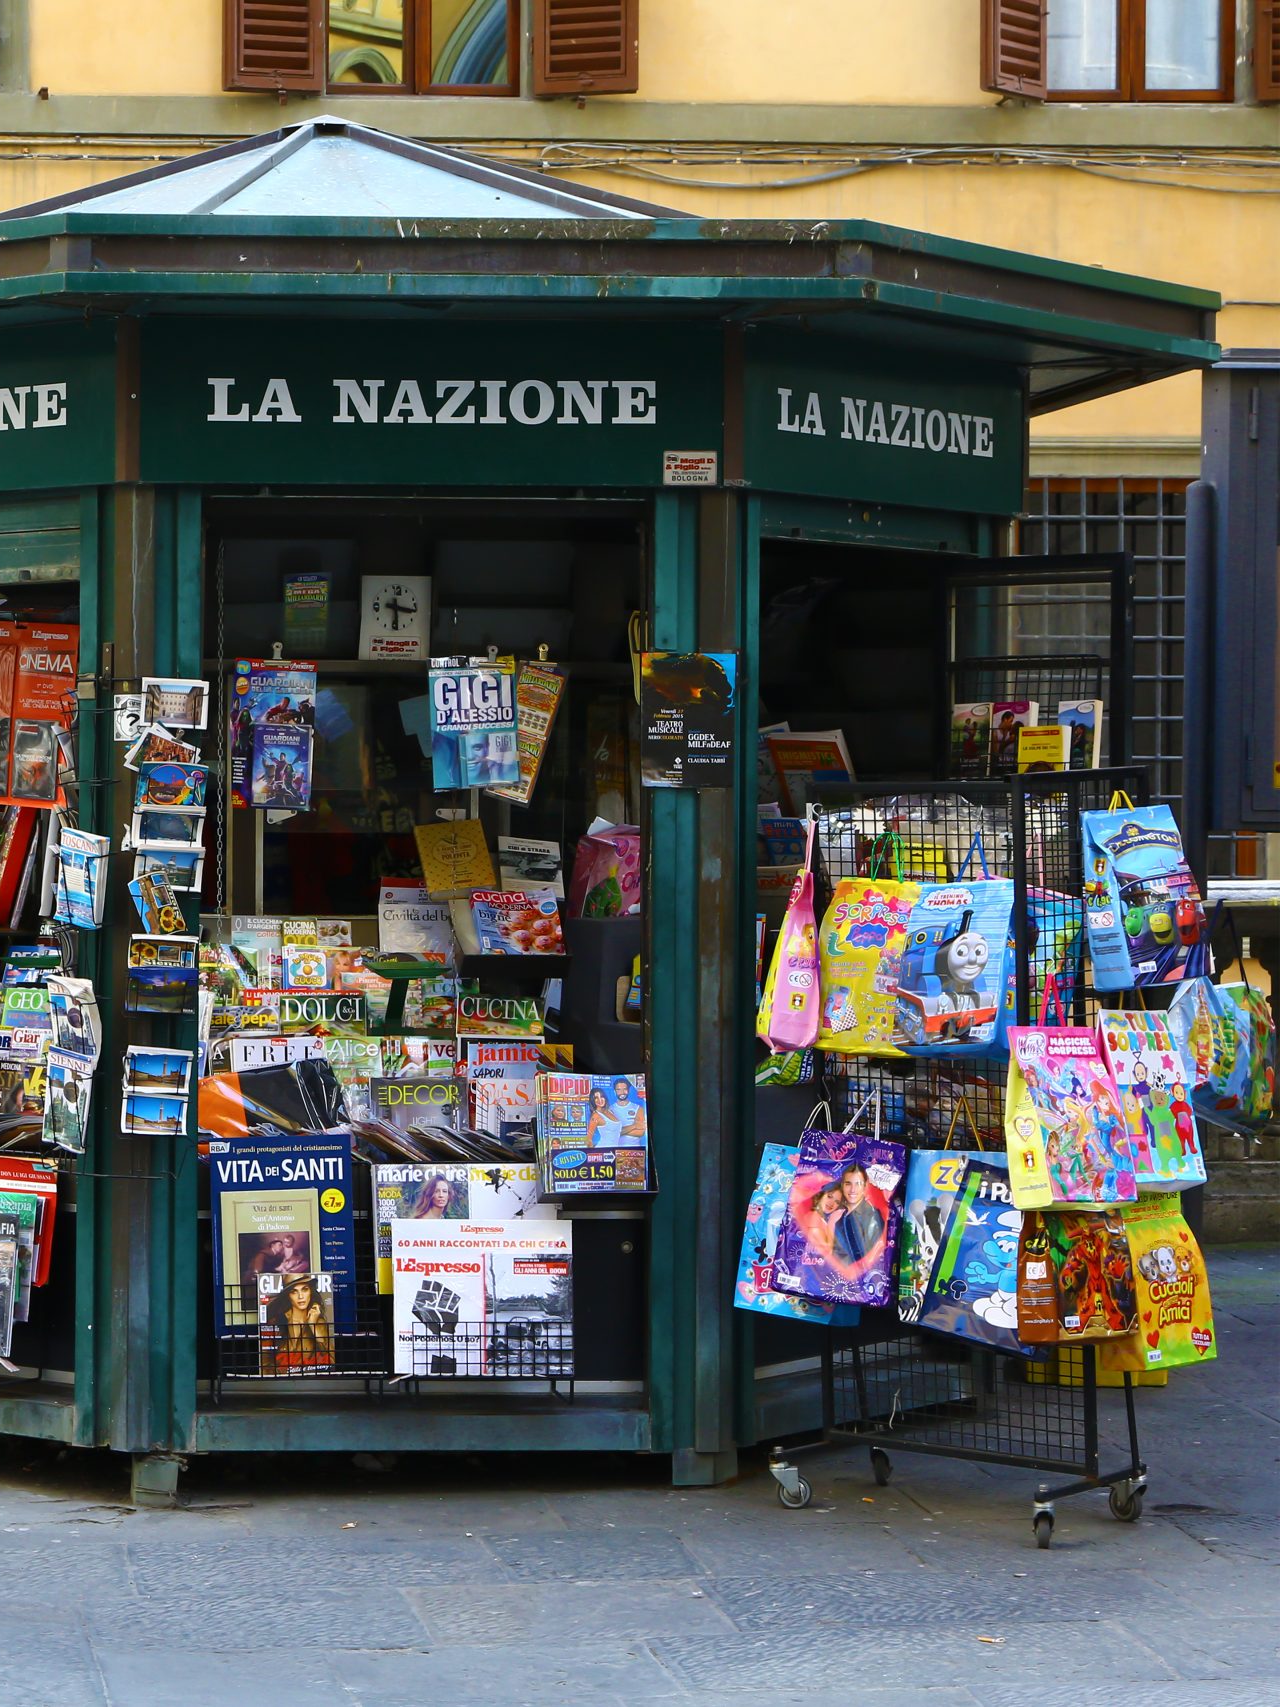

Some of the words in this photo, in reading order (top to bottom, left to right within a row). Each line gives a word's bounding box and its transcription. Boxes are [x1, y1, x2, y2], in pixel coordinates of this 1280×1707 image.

[207, 378, 302, 423] LA
[333, 379, 657, 425] NAZIONE
[777, 387, 826, 436] LA
[840, 396, 994, 458] NAZIONE
[19, 653, 74, 674] CINEMA
[250, 677, 315, 690] GUARDIANI
[434, 674, 512, 711] GIGI
[437, 706, 513, 724] D'ALESSIO
[440, 723, 472, 732] GRANDI
[472, 721, 514, 730] SUCCESSI
[495, 736, 512, 748] GIGI
[472, 891, 525, 903] cucina
[927, 897, 969, 908] THOMAS
[488, 901, 533, 910] MODERNA
[422, 909, 438, 922] del
[283, 921, 316, 929] CUCINA
[283, 928, 316, 936] MODERNA
[8, 991, 44, 1010] GEO
[283, 998, 363, 1022] DOLCI
[460, 996, 541, 1021] CUCINA
[241, 1013, 276, 1028] pepe
[329, 1039, 379, 1058] Alice
[472, 1043, 540, 1066] jamie
[50, 1053, 89, 1072] SIENNE
[472, 1067, 505, 1079] SAPORI
[388, 1085, 461, 1105] DECOR
[236, 1146, 256, 1154] grandi
[256, 1145, 291, 1154] protagonisti
[217, 1160, 264, 1183] VITA
[265, 1166, 280, 1176] DEI
[281, 1158, 343, 1181] SANTI
[554, 1169, 577, 1179] SOLO
[578, 1167, 589, 1179] €
[590, 1166, 613, 1179] 1,50
[252, 1214, 295, 1223] Sant'Antonio
[440, 1240, 501, 1248] RACCONTATI
[503, 1240, 516, 1248] DA
[519, 1240, 535, 1248] CHI
[538, 1240, 567, 1249] C'ERA
[549, 1267, 567, 1275] BOOM
[1149, 1276, 1195, 1303] Cuccioli
[1158, 1300, 1191, 1328] Amici
[399, 1334, 412, 1342] Noi
